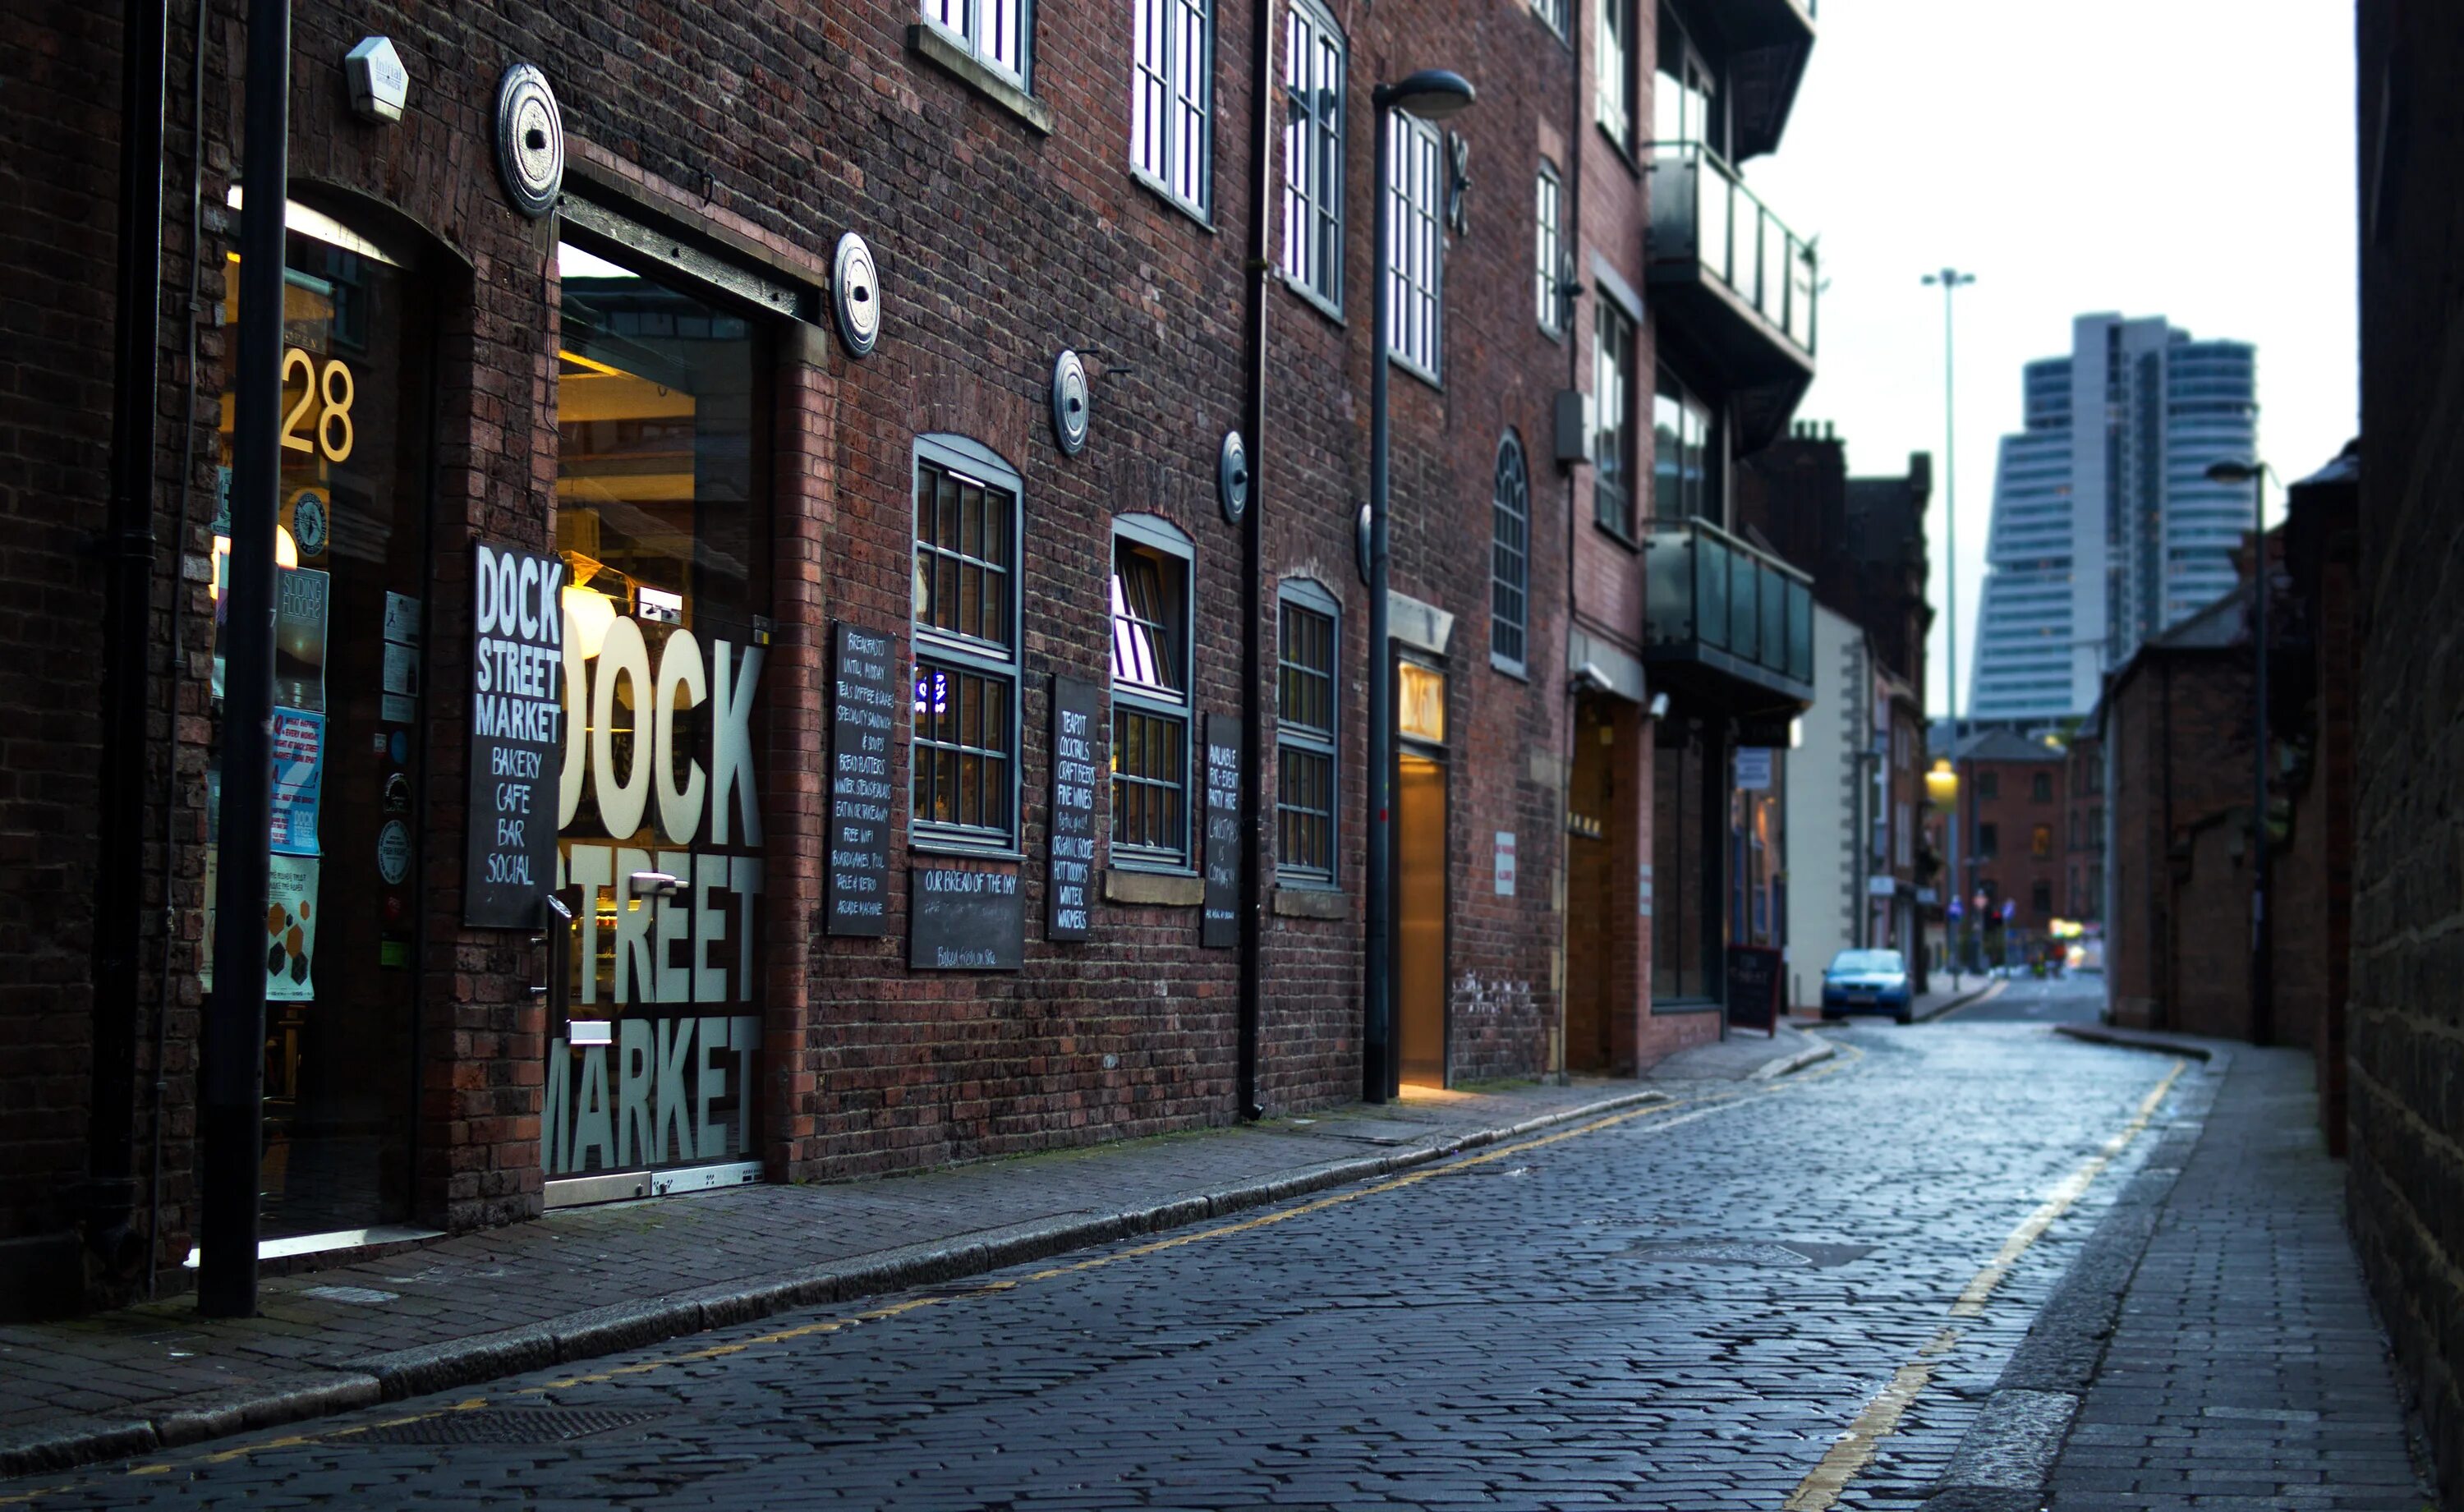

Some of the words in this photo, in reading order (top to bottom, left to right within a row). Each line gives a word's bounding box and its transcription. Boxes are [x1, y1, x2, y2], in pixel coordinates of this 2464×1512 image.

[280, 348, 354, 462] 28
[283, 575, 322, 601] SLIDING
[478, 545, 563, 645] DOCK
[847, 631, 885, 656] BREAKFASTS
[477, 637, 562, 700] STREET
[865, 662, 885, 682] MIDDAY
[837, 681, 853, 699] TEAS
[854, 684, 875, 704] COFFEE
[879, 690, 894, 708] CAKES
[476, 693, 562, 743] MARKET
[1062, 710, 1087, 736] TEAPOT
[867, 735, 885, 752] SOUPS
[1060, 736, 1089, 761] COCKTAILS
[492, 747, 542, 779] BAKERY
[839, 753, 858, 771] BREAD
[858, 755, 886, 775] PLATTERS
[1058, 760, 1078, 783] CRAFT
[1078, 763, 1096, 786] BEERS
[1221, 769, 1239, 788] EVENT
[496, 783, 531, 814] CAFE
[1057, 784, 1073, 806] FINE
[1073, 786, 1092, 810] WINES
[1208, 788, 1225, 808] PARTY
[1225, 792, 1237, 811] HIRE
[854, 802, 862, 820] OR
[498, 818, 526, 848] BAR
[844, 826, 859, 843] FREE
[1052, 834, 1077, 857] ORGANIC
[1078, 838, 1094, 860] BOOZE
[1218, 845, 1225, 862] IS
[486, 853, 534, 885] SOCIAL
[1054, 860, 1067, 881] HOT
[835, 873, 852, 890] TABLE
[859, 876, 876, 893] RETRO
[926, 870, 943, 892] OUR
[945, 871, 972, 893] BREAD
[973, 873, 985, 893] OF
[986, 873, 1002, 894] THE
[1003, 874, 1018, 894] DAY
[837, 899, 858, 917] ARCADE
[859, 900, 883, 917] MACHINE
[1060, 885, 1083, 907] WINTER
[1057, 908, 1087, 929] WARMERS
[938, 945, 958, 967] Baked
[958, 946, 977, 967] fresh
[540, 1016, 763, 1175] MARKET
